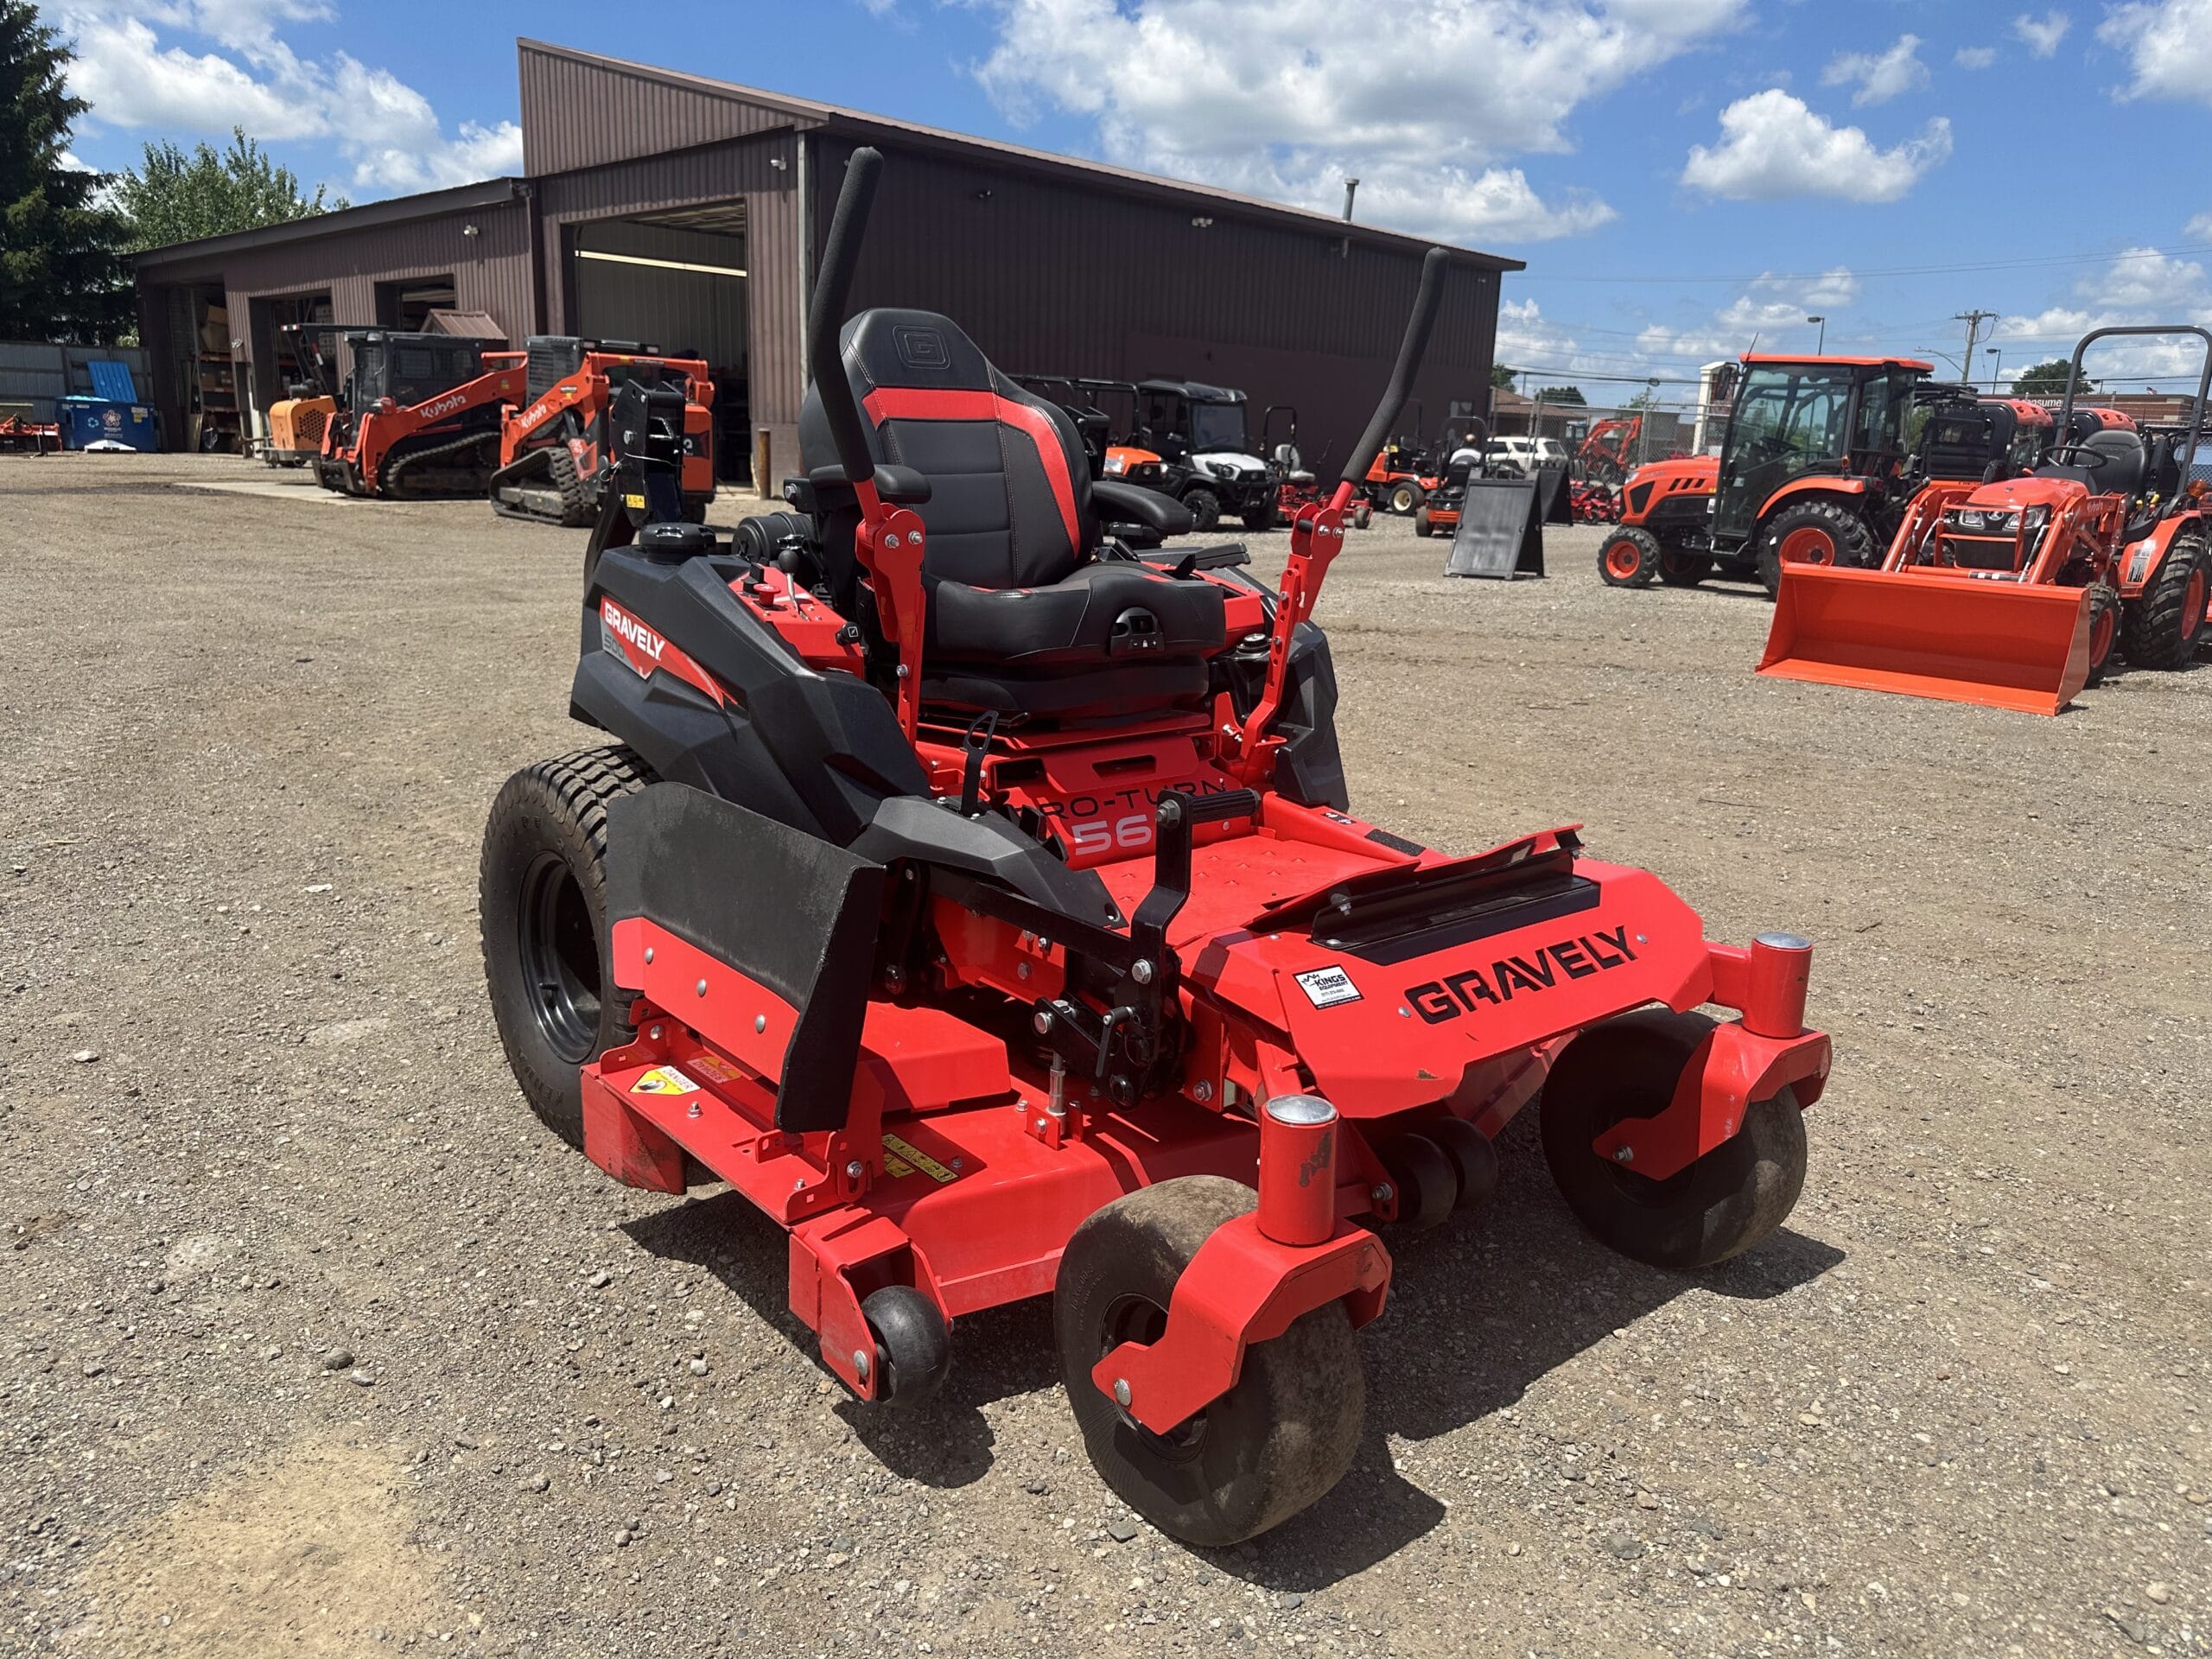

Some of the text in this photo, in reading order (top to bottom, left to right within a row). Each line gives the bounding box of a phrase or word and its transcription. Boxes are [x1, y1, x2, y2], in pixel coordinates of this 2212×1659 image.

[420, 393, 467, 418] Kubota
[520, 403, 547, 429] Kubota
[605, 601, 665, 660] GRAVELY
[1018, 779, 1227, 819] RO-TURN
[1071, 814, 1153, 855] 56
[1314, 974, 1346, 987] KINGS
[1404, 925, 1638, 1025] GRAVELY
[662, 1068, 694, 1090] DANGER
